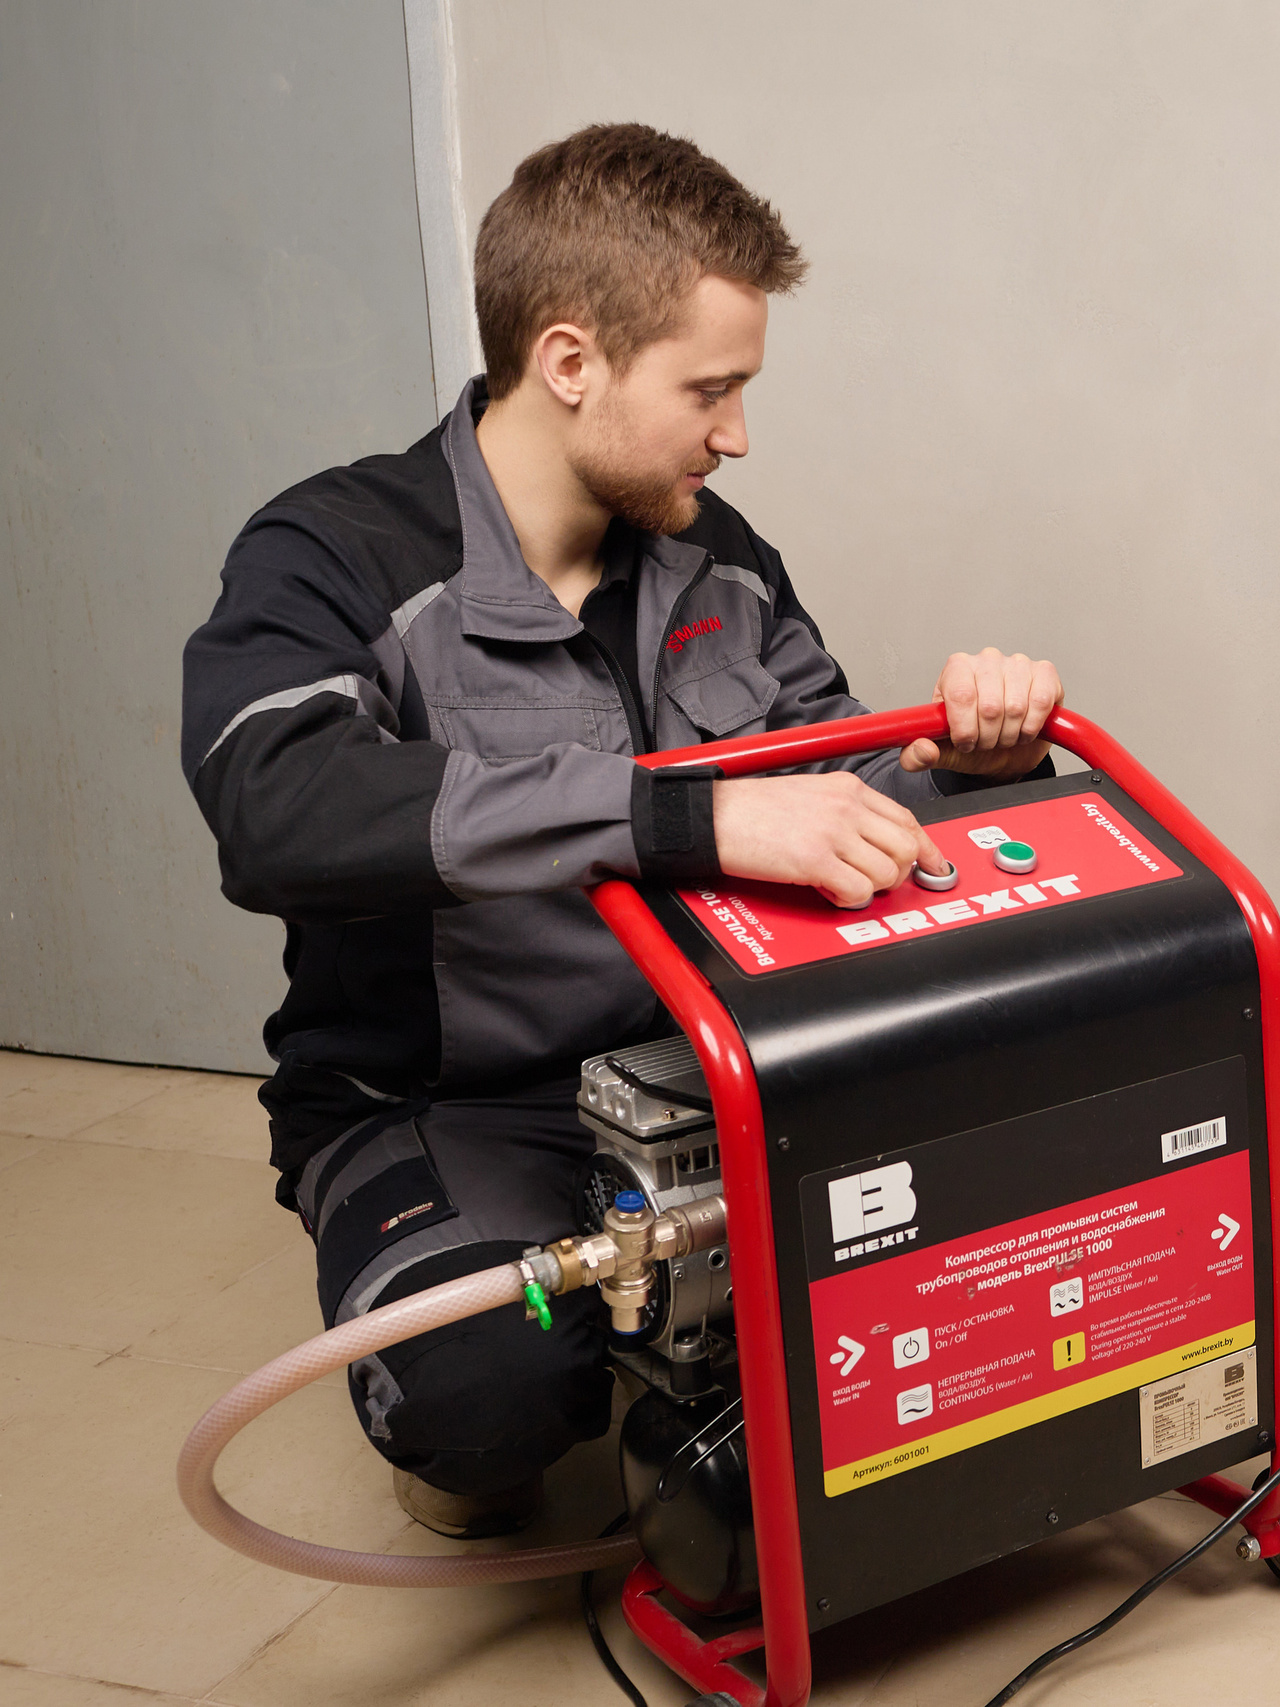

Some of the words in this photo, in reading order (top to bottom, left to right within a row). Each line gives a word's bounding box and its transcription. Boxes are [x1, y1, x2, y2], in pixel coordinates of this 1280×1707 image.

[1081, 803, 1160, 872] www.brexit.by
[728, 896, 759, 925] 6001001
[835, 874, 1082, 946] BREXIT
[712, 906, 776, 967] BrexPULSE
[834, 1226, 919, 1262] BREXIT
[915, 1257, 1009, 1295] трубопроводов
[1009, 1237, 1070, 1265] отопления
[1071, 1235, 1080, 1246] и
[1080, 1207, 1166, 1243] водоснабжения
[945, 1238, 1016, 1269] Компрессор
[1018, 1231, 1040, 1248] для
[1040, 1213, 1099, 1241] промывки
[1100, 1201, 1138, 1220] систем
[977, 1269, 1022, 1292] модель
[1023, 1246, 1084, 1276] BrexPULSE
[1085, 1238, 1113, 1257] 1000
[1087, 1256, 1142, 1282] ИМПУЛЬСНАЯ
[1143, 1246, 1176, 1265] ПОДАЧА
[1207, 1259, 1227, 1272] ВЫХОД
[1227, 1254, 1243, 1266] ВОДЫ
[1216, 1267, 1232, 1277] Water
[1232, 1263, 1244, 1272] OUT
[1088, 1271, 1133, 1293] ВОДА/ВОЗДУХ
[1089, 1286, 1122, 1304] IMPULSE
[1123, 1279, 1143, 1294] (Water
[1148, 1274, 1159, 1285] Air)
[934, 1321, 957, 1337] ПУСК
[963, 1304, 1015, 1328] ОСТАНОВКА
[1090, 1323, 1099, 1332] Во
[1099, 1317, 1119, 1330] время
[1120, 1309, 1143, 1323] работы
[1143, 1296, 1178, 1314] обеспечьте
[1090, 1323, 1127, 1341] стабильное
[1127, 1311, 1165, 1331] напряжение
[1170, 1303, 1184, 1314] сети
[935, 1340, 948, 1350] On
[954, 1331, 968, 1345] Off
[1091, 1338, 1112, 1353] During
[1143, 1322, 1164, 1334] ensure
[1169, 1313, 1187, 1325] stable
[1091, 1348, 1115, 1362] voltage
[1115, 1344, 1122, 1353] of
[1122, 1337, 1147, 1352] 220-240
[1181, 1337, 1234, 1362] www.brexit.by
[937, 1361, 999, 1389] НЕПРЕРЫВНАЯ
[1000, 1348, 1036, 1368] ПОДАЧА
[832, 1385, 850, 1398] ВХОД
[850, 1379, 871, 1392] ВОДЫ
[833, 1396, 851, 1407] Water
[851, 1392, 860, 1401] IN
[938, 1376, 986, 1399] ВОДА/ВОЗДУХ
[939, 1384, 994, 1410] CONTINUOUS
[995, 1378, 1017, 1392] (Water
[1021, 1372, 1033, 1382] Air)
[853, 1459, 892, 1479] Артикул:
[893, 1445, 930, 1465] 6001001
